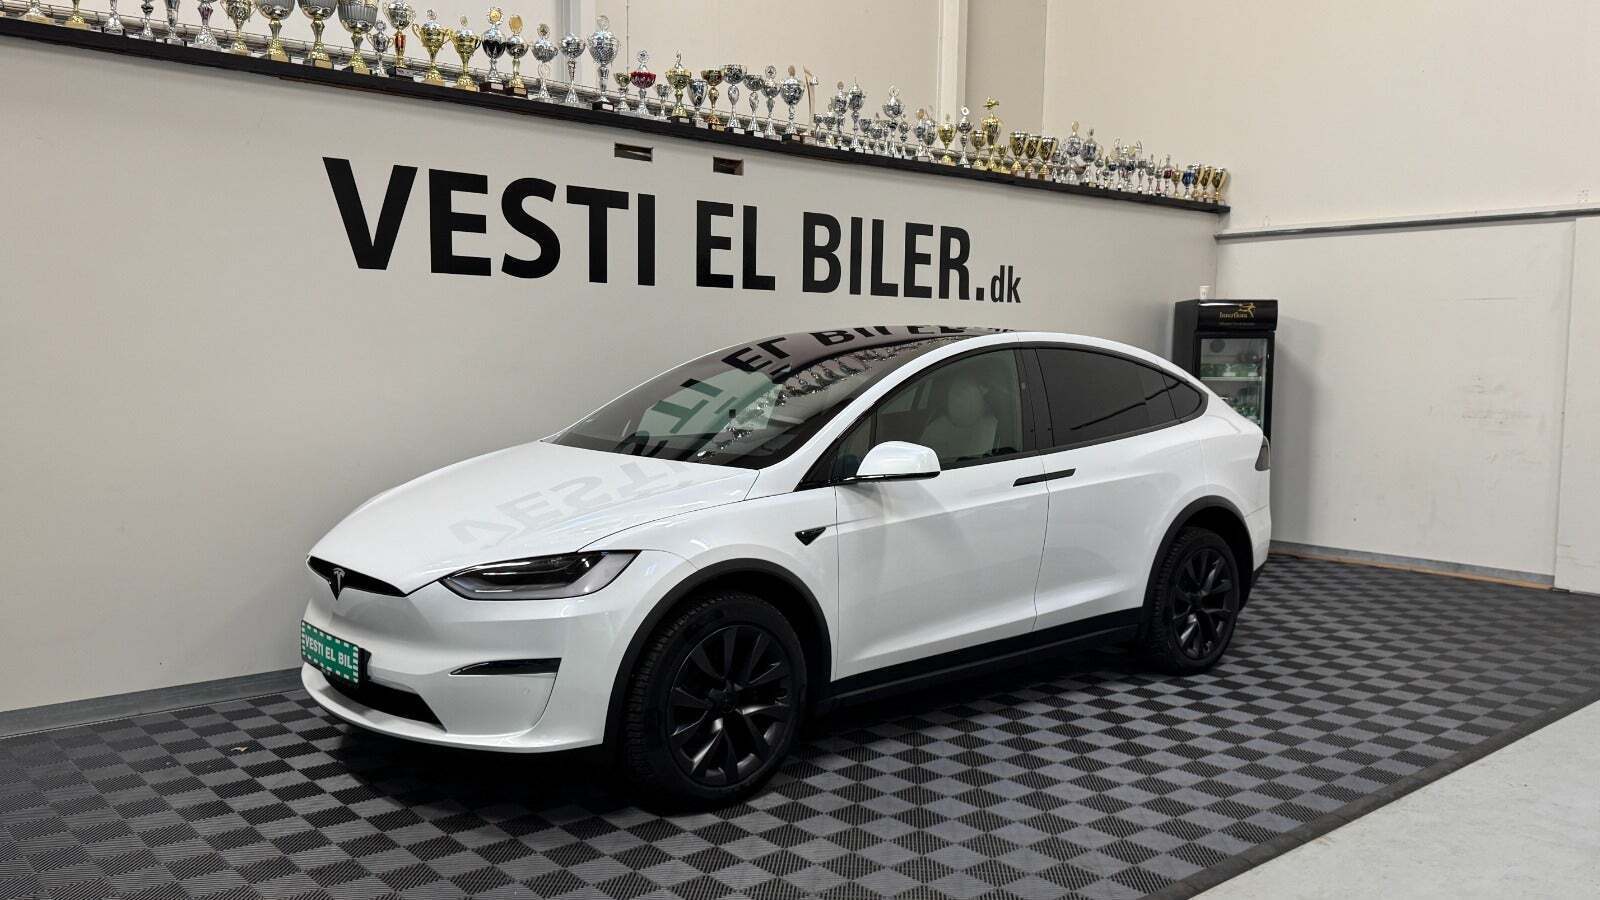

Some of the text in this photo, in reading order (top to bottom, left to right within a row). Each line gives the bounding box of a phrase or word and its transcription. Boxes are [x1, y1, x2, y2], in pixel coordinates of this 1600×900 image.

[322, 157, 655, 286] VESTI
[696, 200, 775, 291] EL
[305, 634, 353, 669] VESTI EL BIL
